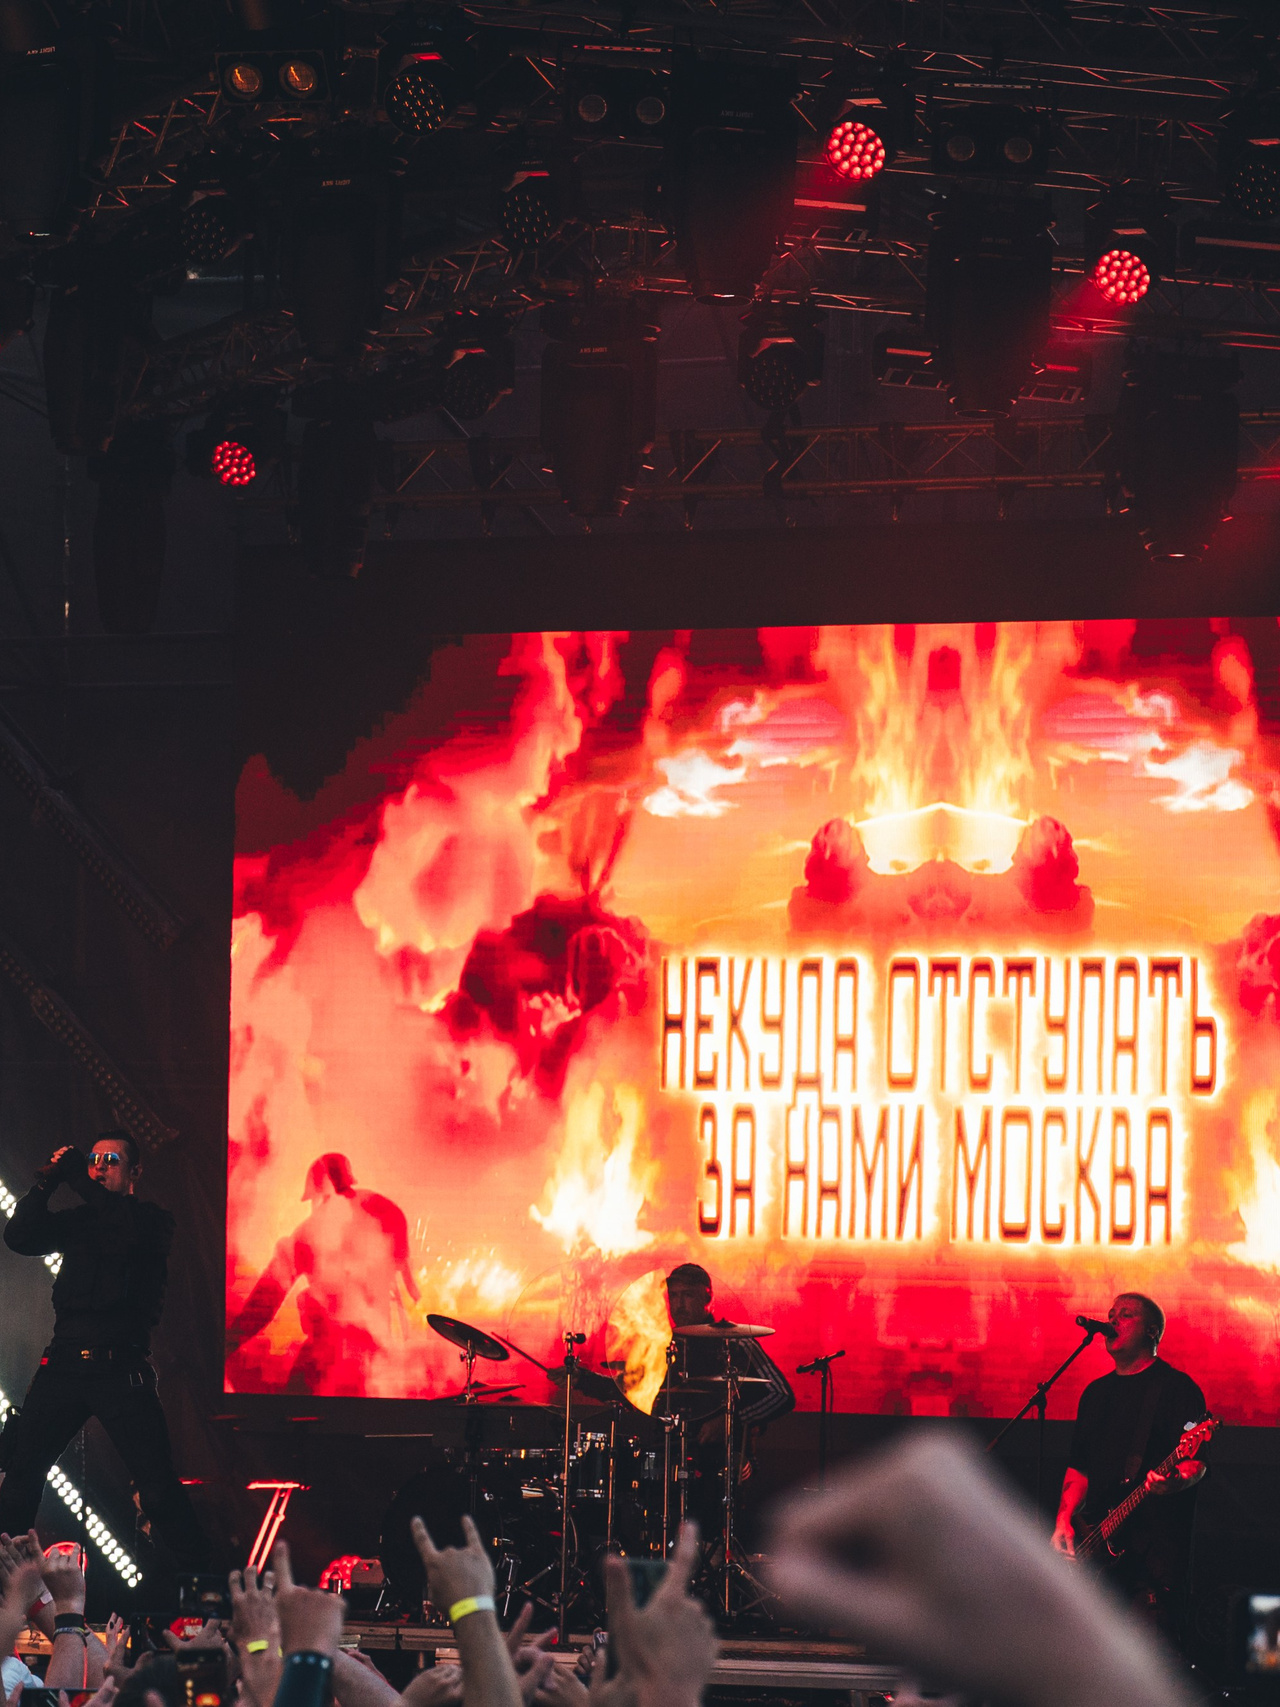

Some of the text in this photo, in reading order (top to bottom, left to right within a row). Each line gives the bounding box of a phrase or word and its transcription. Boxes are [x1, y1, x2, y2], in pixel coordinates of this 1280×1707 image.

[661, 956, 1218, 1110] НЕКУДА ОТСТУПАТЬ
[697, 1102, 1173, 1246] ЗА НАМИ МОСКВА
